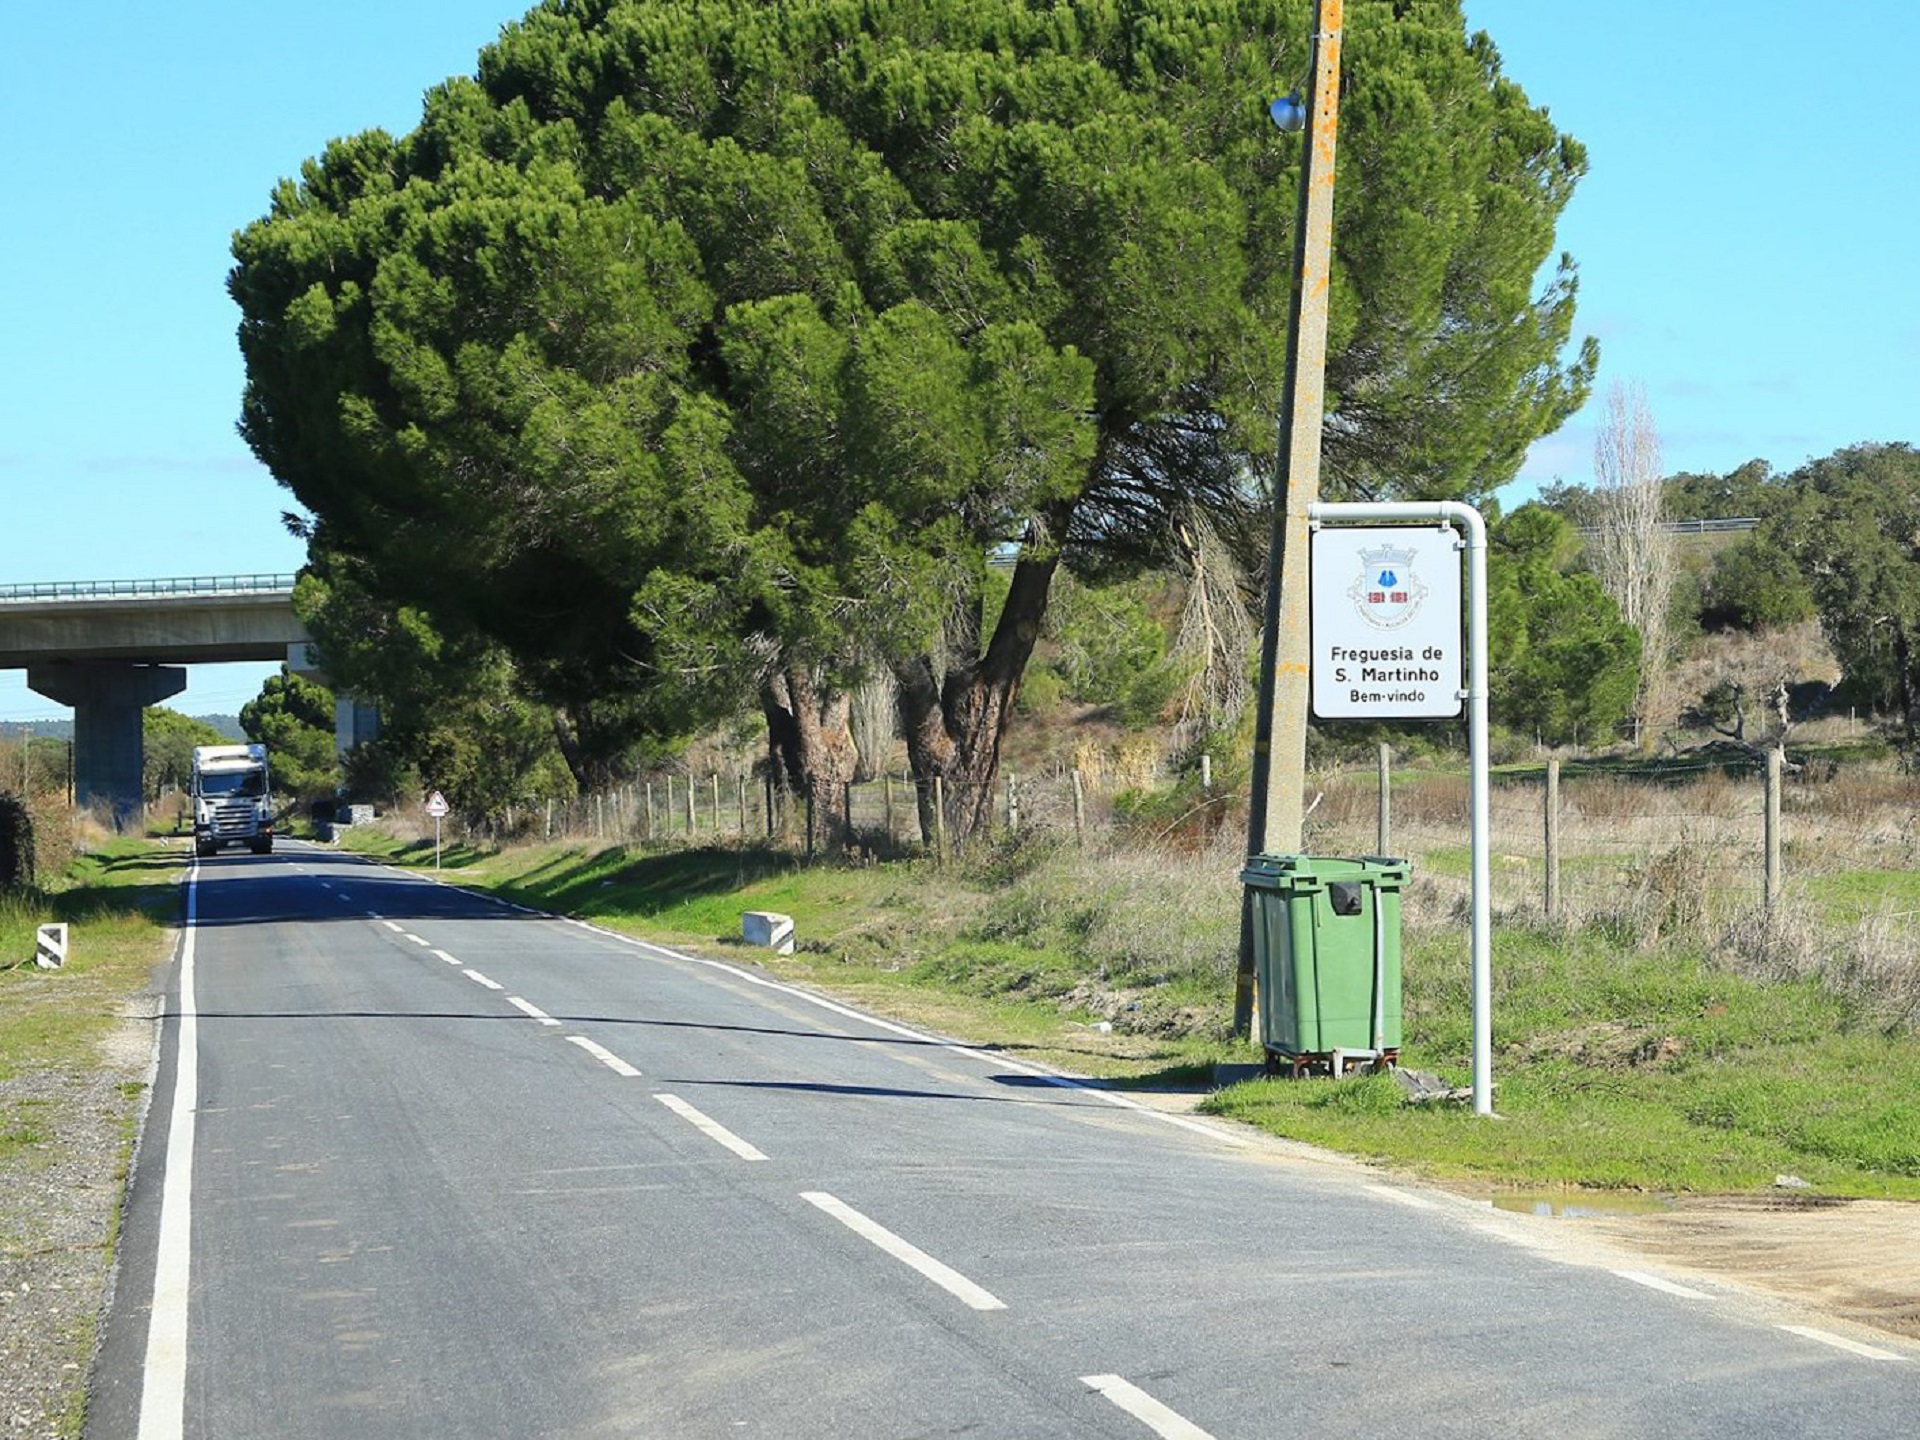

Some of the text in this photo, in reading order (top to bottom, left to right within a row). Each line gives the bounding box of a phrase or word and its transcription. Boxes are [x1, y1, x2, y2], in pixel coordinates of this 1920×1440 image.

[1331, 645, 1443, 664] Freguesia de
[1335, 667, 1439, 682] S. Martinho
[1350, 689, 1425, 703] Bem-vindo
